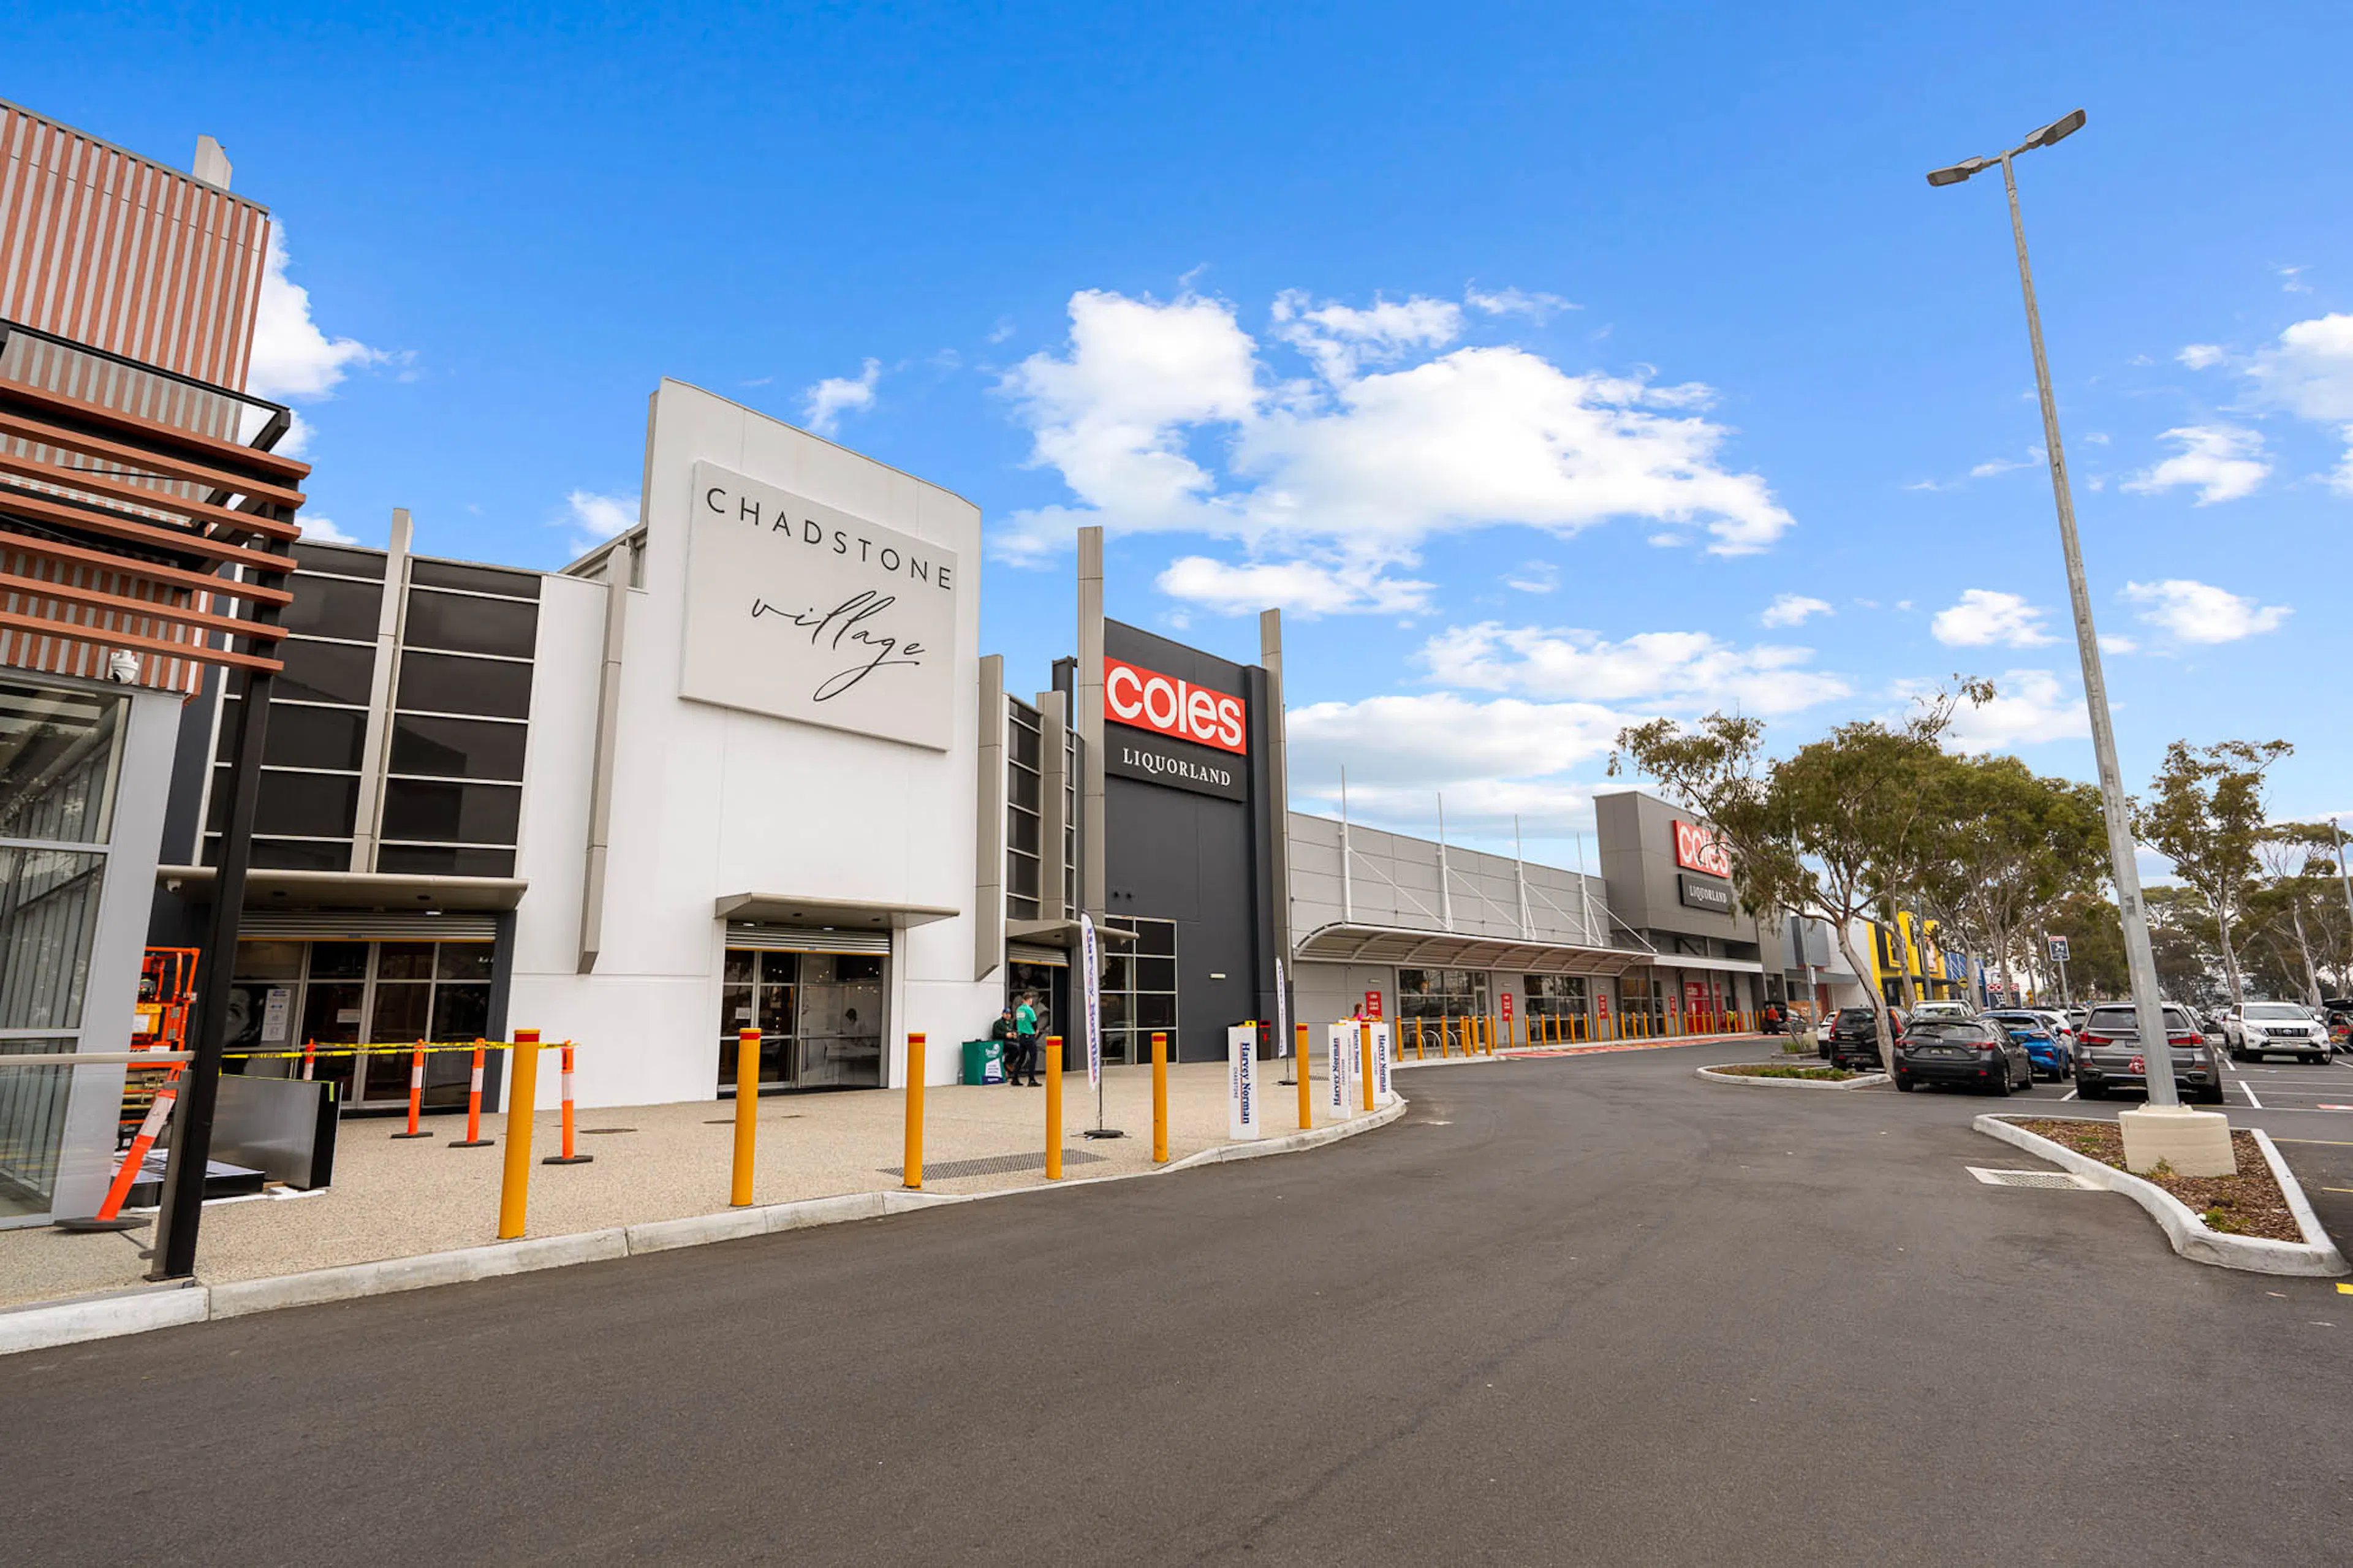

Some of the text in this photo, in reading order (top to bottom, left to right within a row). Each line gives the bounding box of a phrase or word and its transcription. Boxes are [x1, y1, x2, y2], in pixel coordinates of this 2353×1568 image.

[707, 487, 951, 590] CHADSTONE
[751, 590, 925, 702] village
[1107, 666, 1243, 747] coles
[1123, 747, 1231, 787] LIQUORLAND
[1688, 884, 1728, 904] LIQUORLAND
[1240, 1043, 1251, 1124] Harvey Norman
